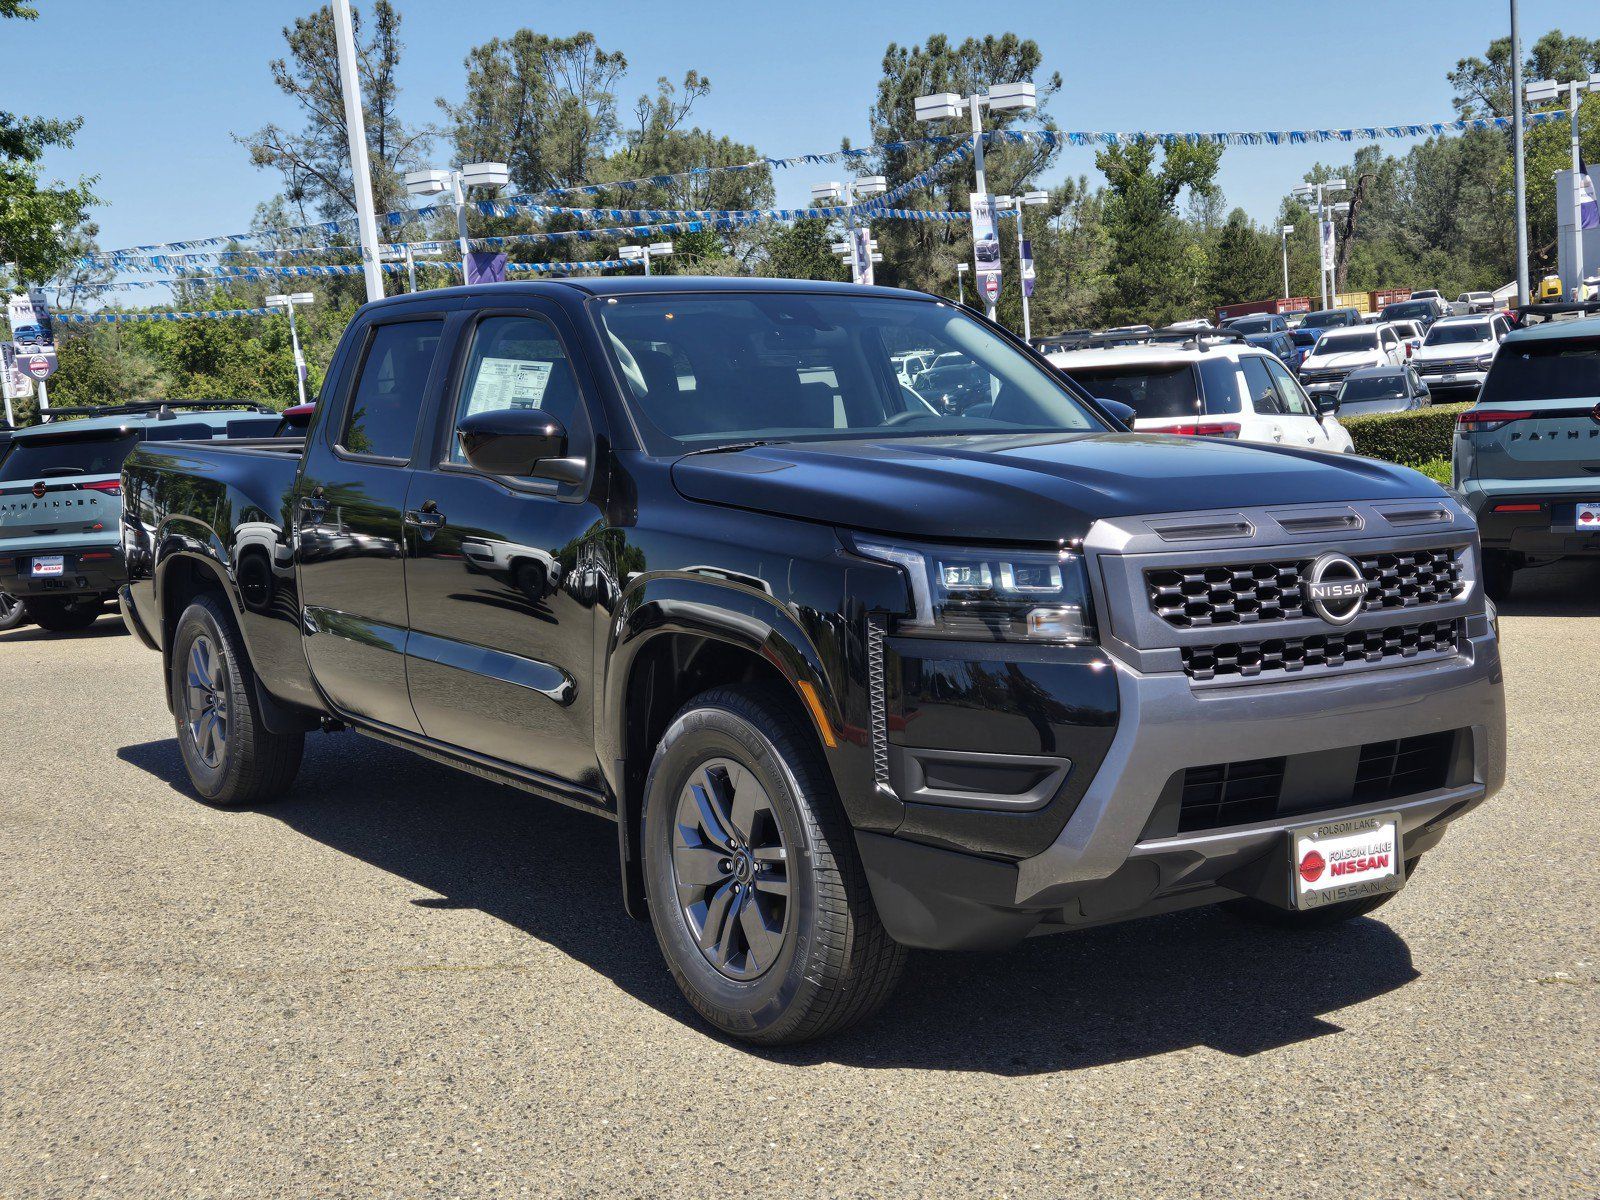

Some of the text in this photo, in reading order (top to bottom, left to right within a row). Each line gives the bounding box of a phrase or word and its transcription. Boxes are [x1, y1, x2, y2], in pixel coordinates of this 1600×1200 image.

[1312, 583, 1369, 598] NISSAN
[1318, 819, 1375, 836] FOLSOM LAKE
[1329, 842, 1392, 862] FOLSOM LAKE
[1331, 855, 1389, 876] NISSAN
[1322, 882, 1380, 902] NISSAN
